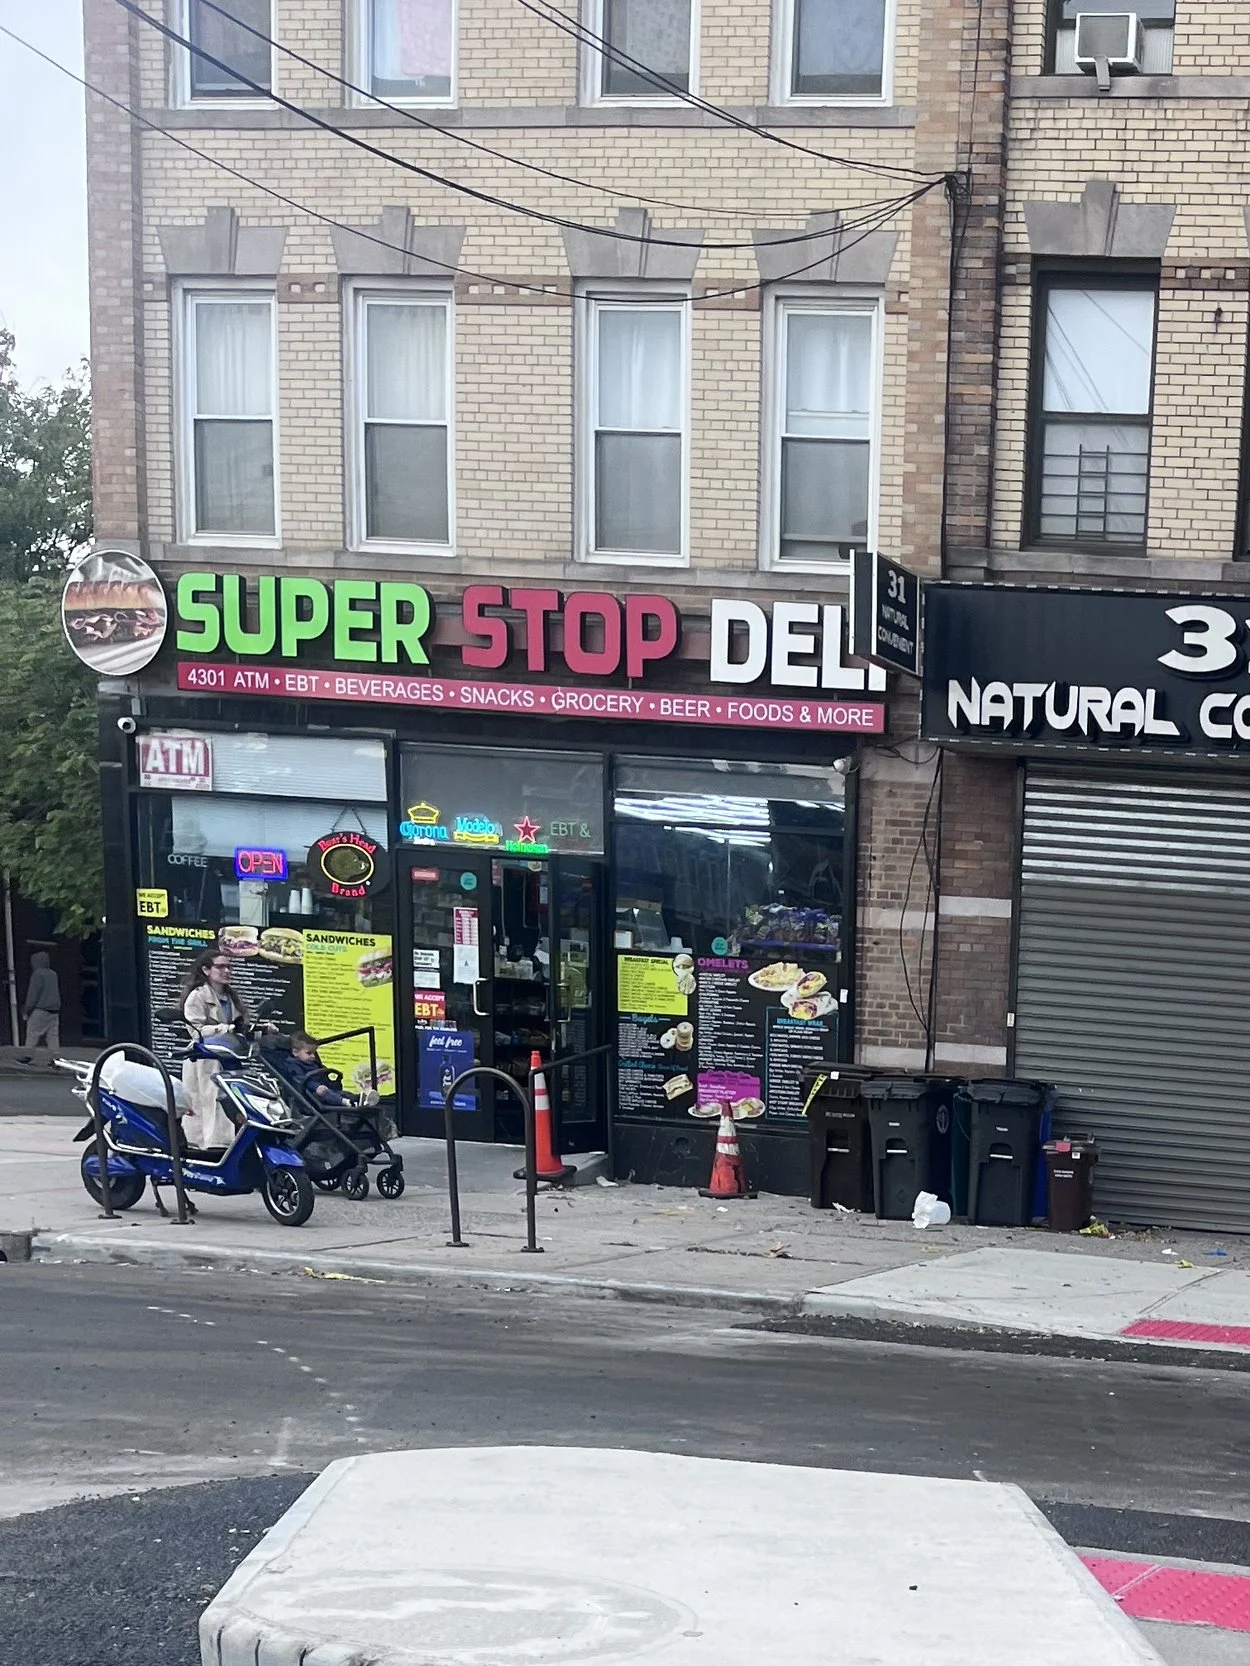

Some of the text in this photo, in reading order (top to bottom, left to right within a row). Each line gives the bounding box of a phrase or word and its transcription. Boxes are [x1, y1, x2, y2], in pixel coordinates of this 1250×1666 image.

[888, 569, 907, 604] 31
[175, 572, 430, 665] SUPER
[461, 584, 678, 678] STOP
[881, 603, 910, 631] NATURAL
[188, 669, 875, 726] 4301 ATM EBT BEVERAGES SNACKS GROCERY BEER FOODS & MORE
[946, 676, 1184, 737] NATURAL
[144, 737, 206, 775] ATM
[400, 820, 449, 840] Corona
[455, 816, 495, 834] Modelo
[550, 821, 592, 838] EBT &
[317, 833, 377, 854] Boar's Head
[167, 853, 209, 868] COFFEE
[238, 850, 284, 875] OPEN
[331, 881, 367, 897] Brand
[139, 900, 161, 914] EBT
[146, 925, 216, 940] SANDWICHES
[306, 933, 376, 947] SANDWICHES
[414, 1002, 439, 1017] EBT
[429, 1035, 463, 1049] feel free
